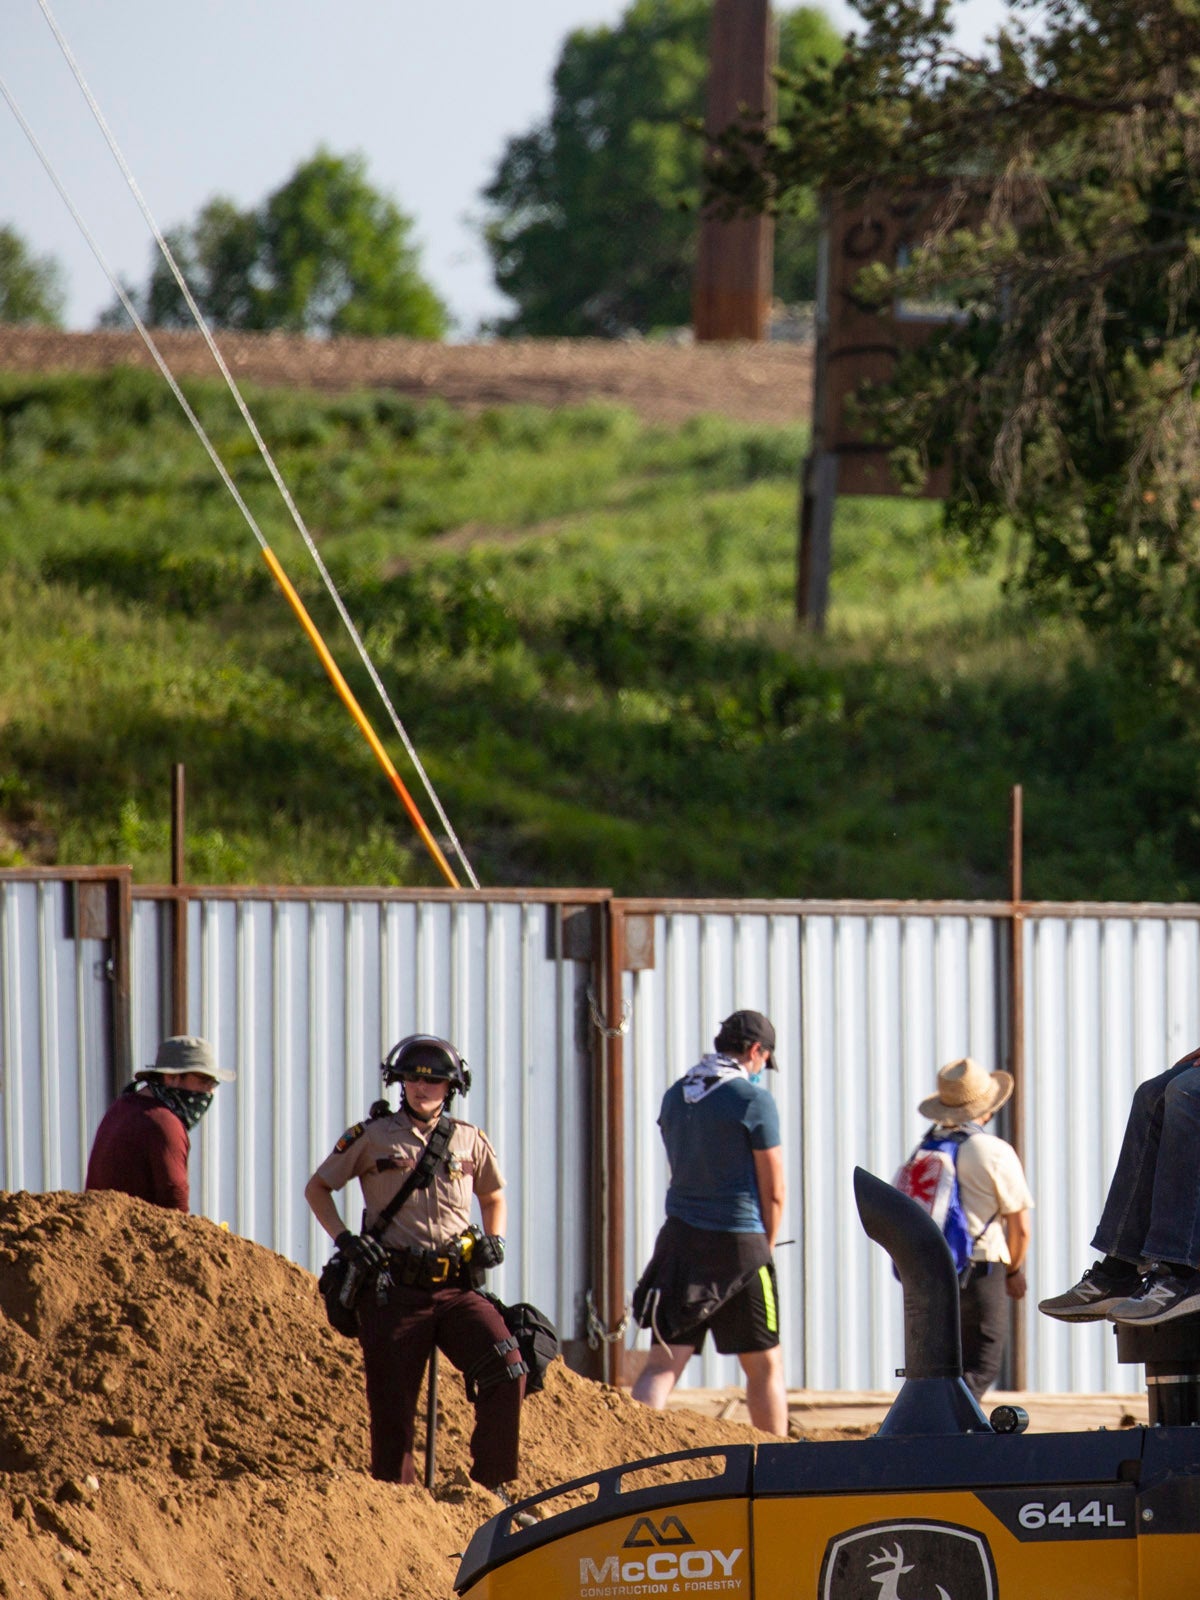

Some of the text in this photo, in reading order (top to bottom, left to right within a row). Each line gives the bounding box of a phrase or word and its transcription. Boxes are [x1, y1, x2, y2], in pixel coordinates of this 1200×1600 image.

[1018, 1500, 1126, 1529] 644L
[579, 1549, 743, 1584] McCOY
[580, 1579, 743, 1598] CONSTRUCTION & FORESTRY
